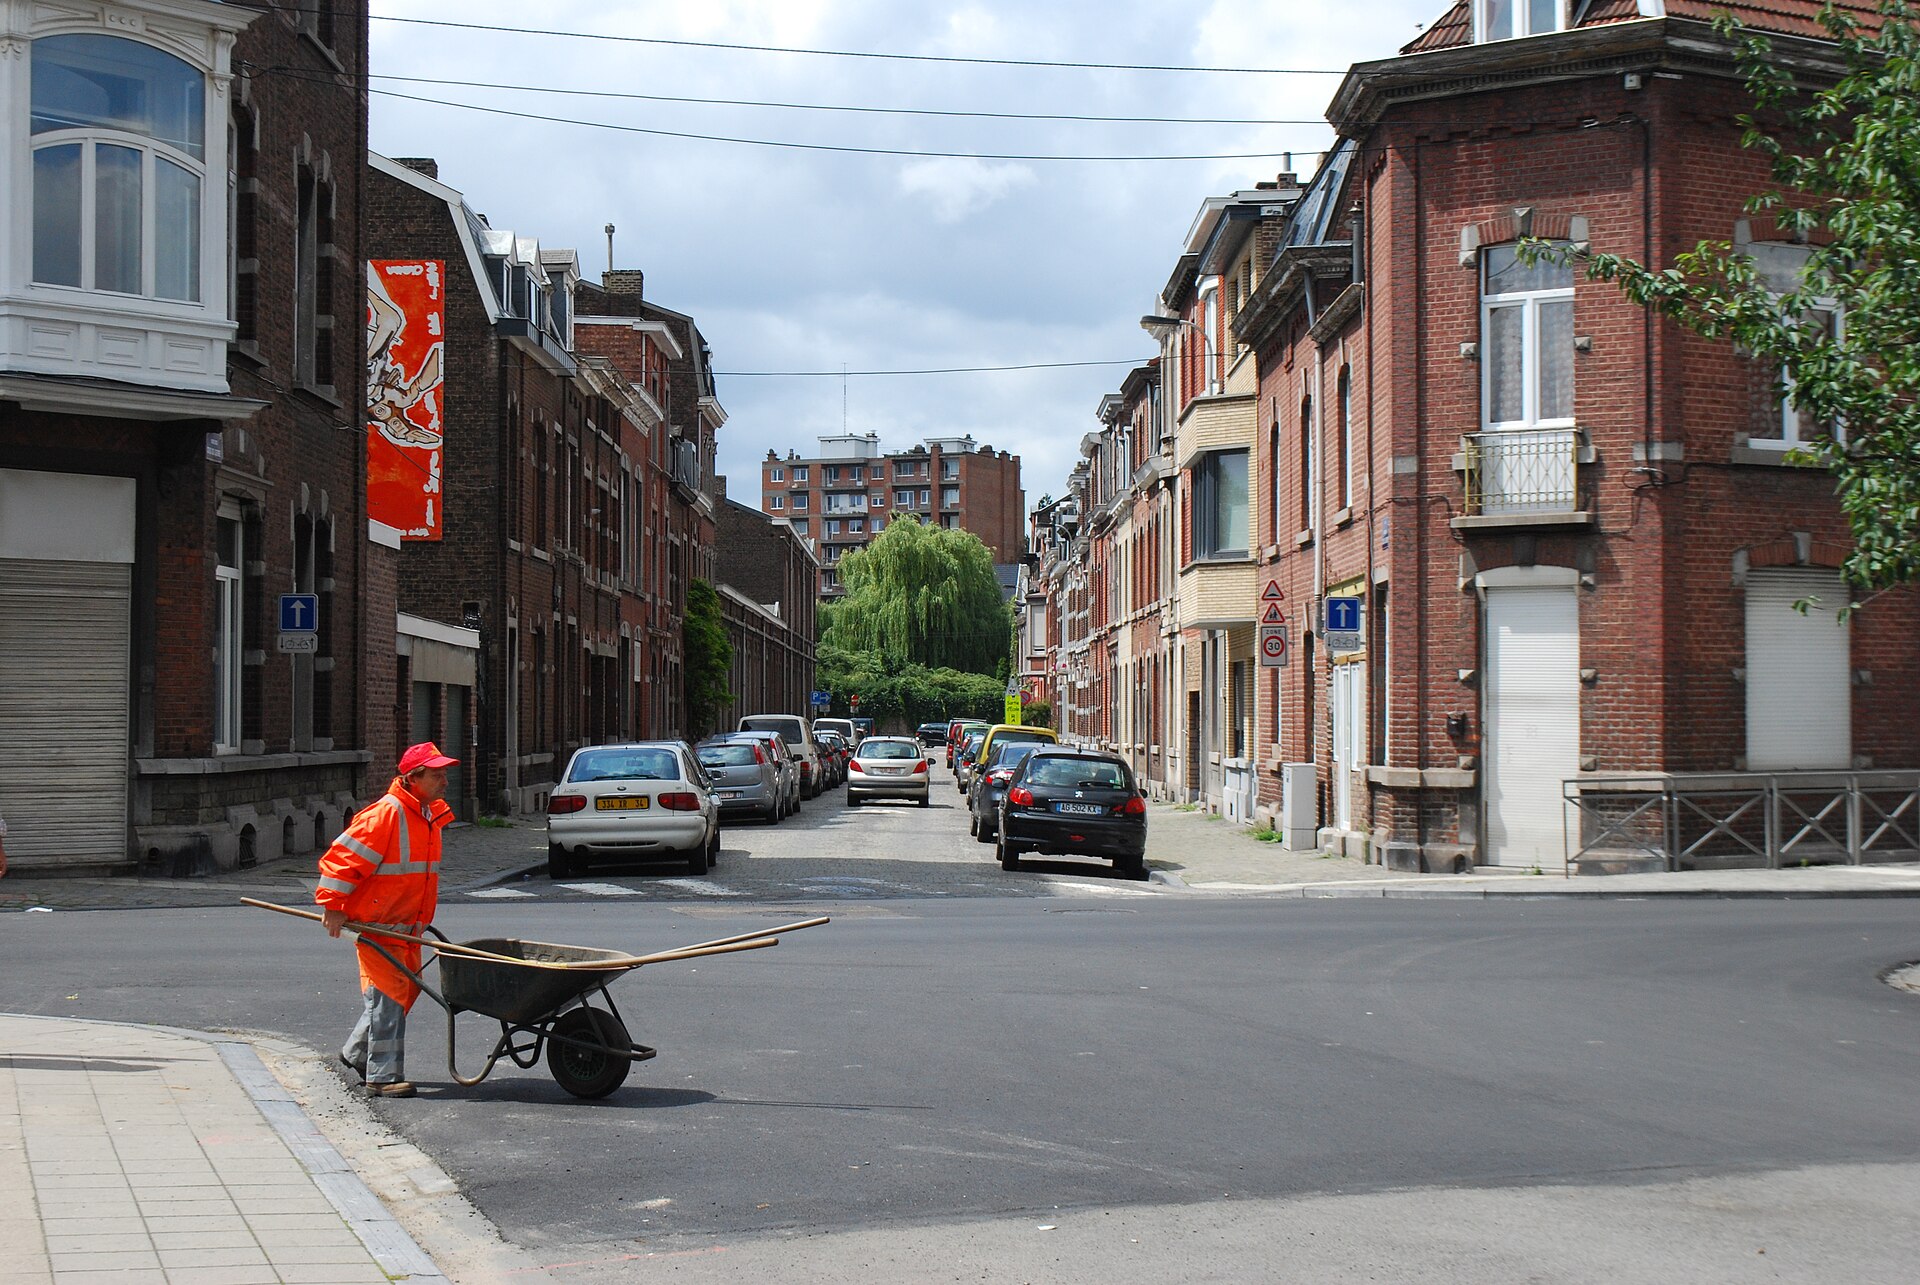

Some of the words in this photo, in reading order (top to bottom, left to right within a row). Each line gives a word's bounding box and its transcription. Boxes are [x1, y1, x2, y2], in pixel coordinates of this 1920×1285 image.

[1267, 642, 1280, 651] 30
[812, 693, 818, 701] P
[602, 801, 614, 809] 334
[618, 800, 627, 808] XR
[635, 799, 644, 808] 34
[1061, 803, 1070, 811] AG
[1072, 804, 1086, 812] 502
[1088, 804, 1097, 813] KX
